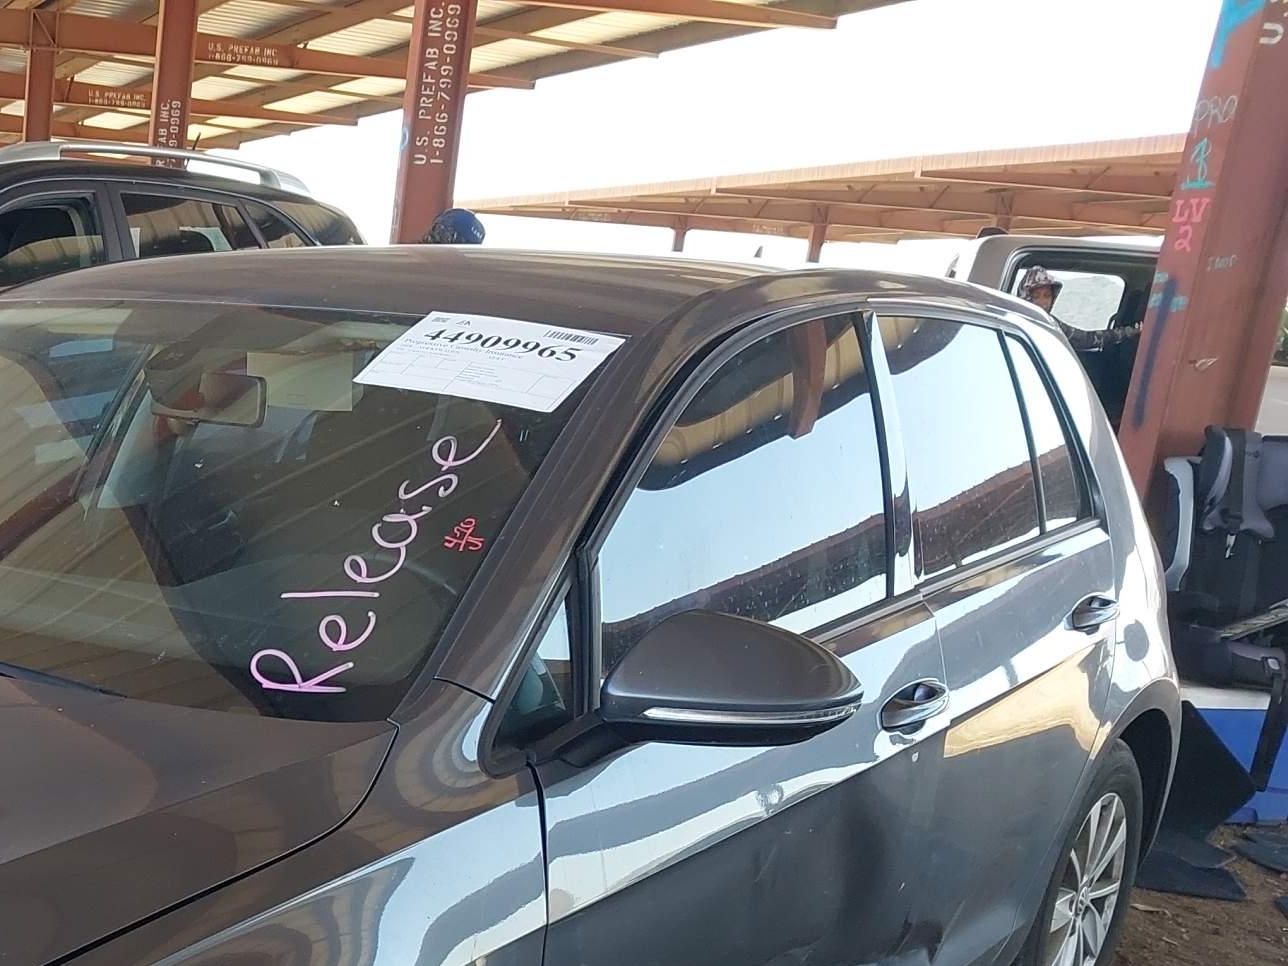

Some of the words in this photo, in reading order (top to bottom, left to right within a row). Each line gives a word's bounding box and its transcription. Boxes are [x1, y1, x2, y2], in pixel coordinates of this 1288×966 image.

[428, 1, 445, 37] INC.
[228, 44, 261, 55] PREFAB
[419, 48, 439, 119] PREFAB
[430, 4, 461, 164] 1-866-799-0969
[414, 131, 431, 165] U.S.
[423, 328, 584, 362] 44909965
[250, 418, 503, 693] Release
